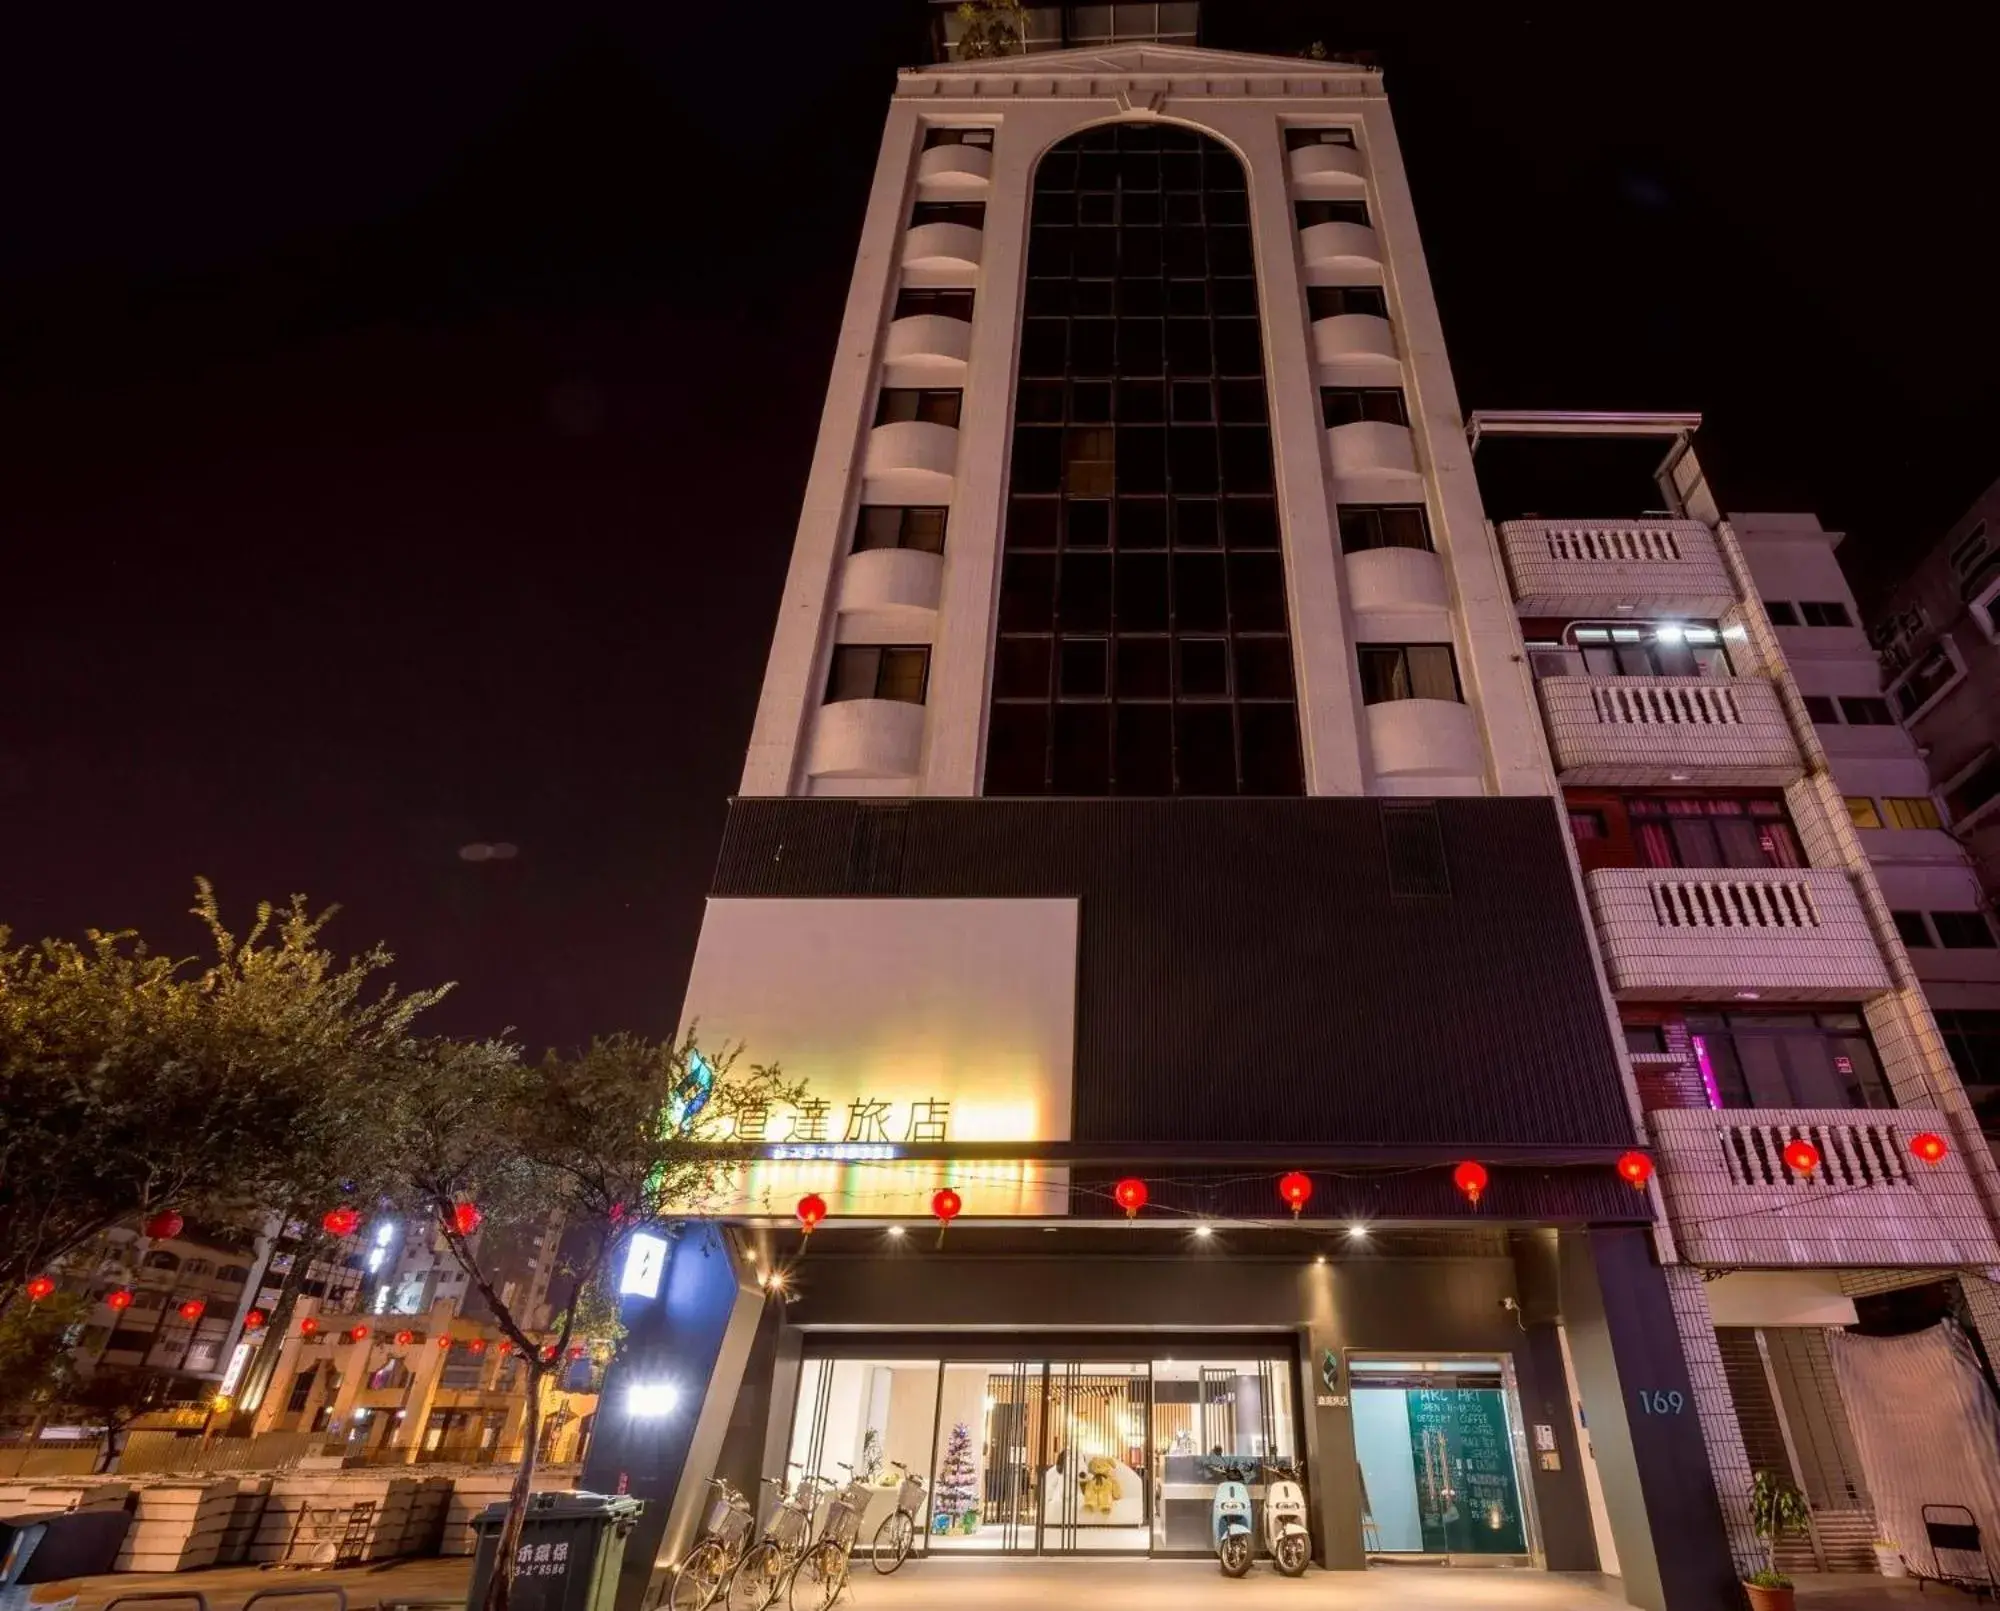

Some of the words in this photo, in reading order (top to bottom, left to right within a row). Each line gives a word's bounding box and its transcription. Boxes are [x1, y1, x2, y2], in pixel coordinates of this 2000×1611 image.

[723, 1096, 951, 1143] 道達旅店
[1639, 1390, 1684, 1415] 169
